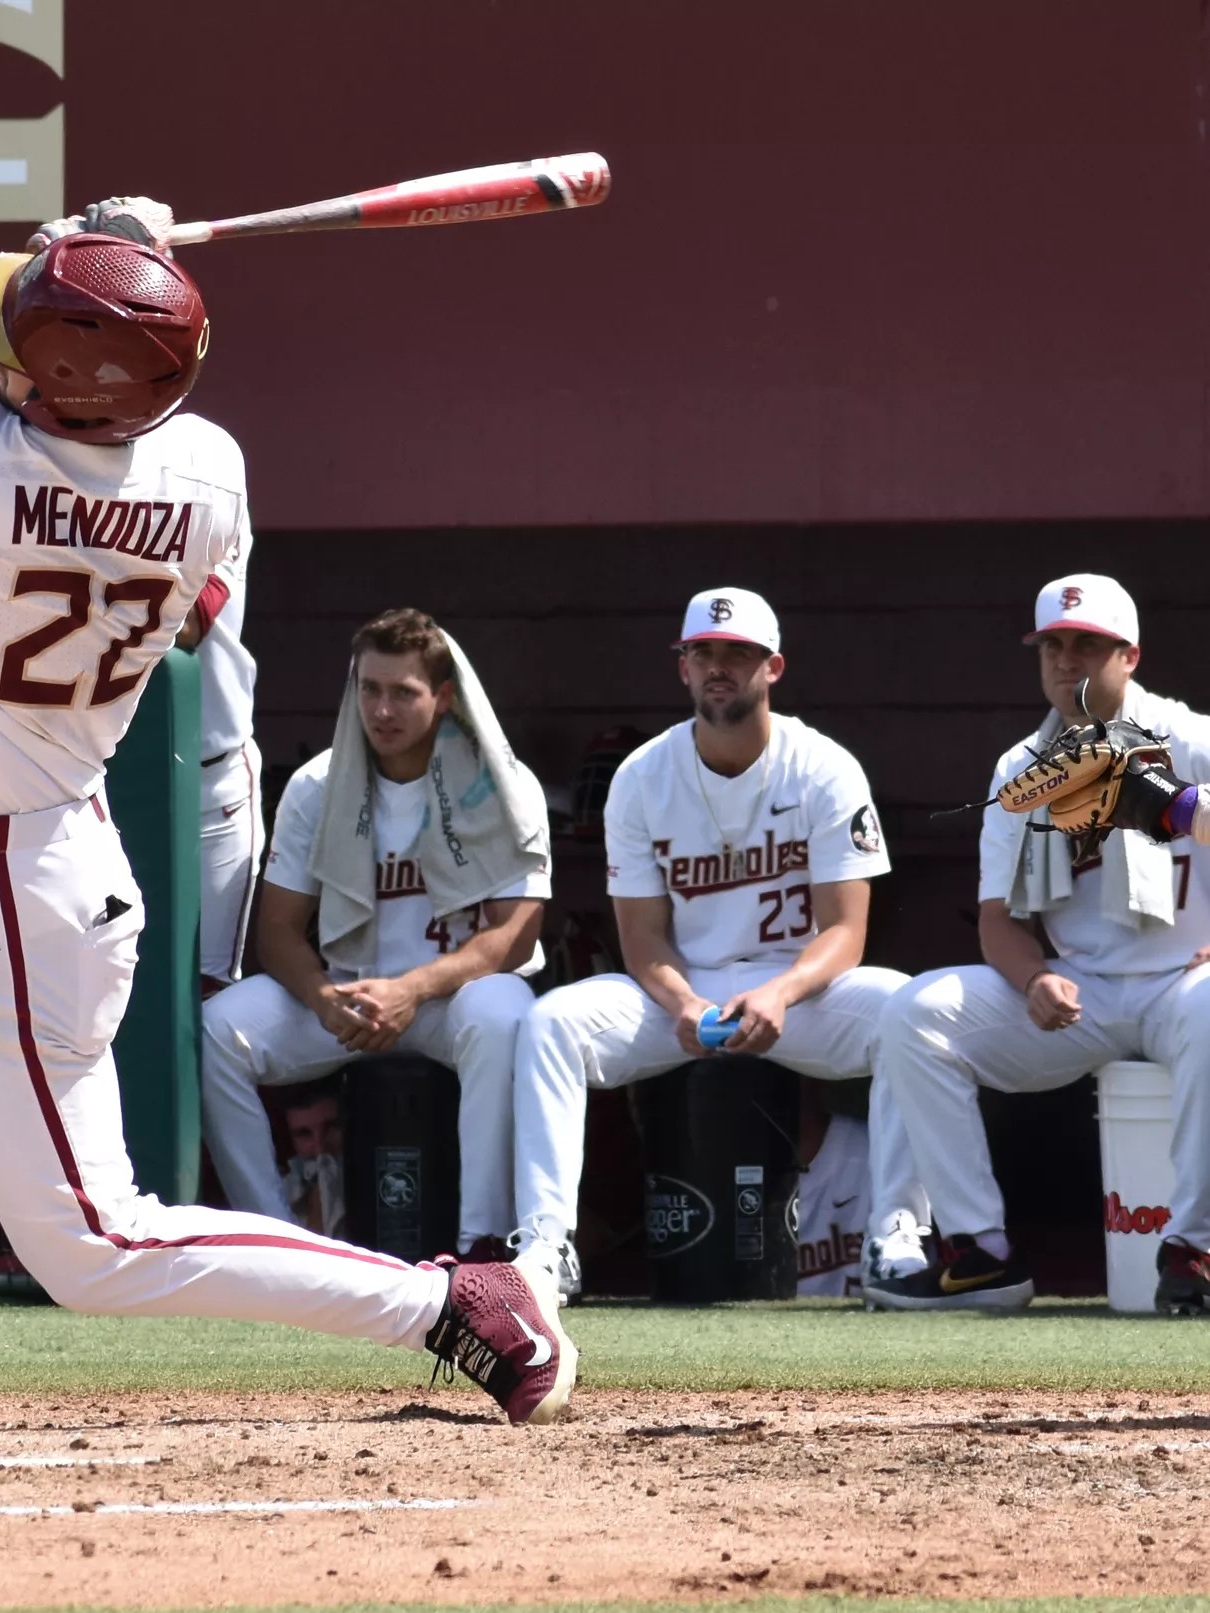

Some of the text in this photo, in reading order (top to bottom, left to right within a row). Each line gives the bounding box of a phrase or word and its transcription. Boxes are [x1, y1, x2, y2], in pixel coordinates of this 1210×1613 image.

[407, 196, 528, 225] LOUISVILLE
[53, 397, 113, 405] EVOSHIELD
[11, 484, 193, 562] MENDOZA
[1012, 769, 1069, 806] EASTON
[758, 883, 813, 944] 23
